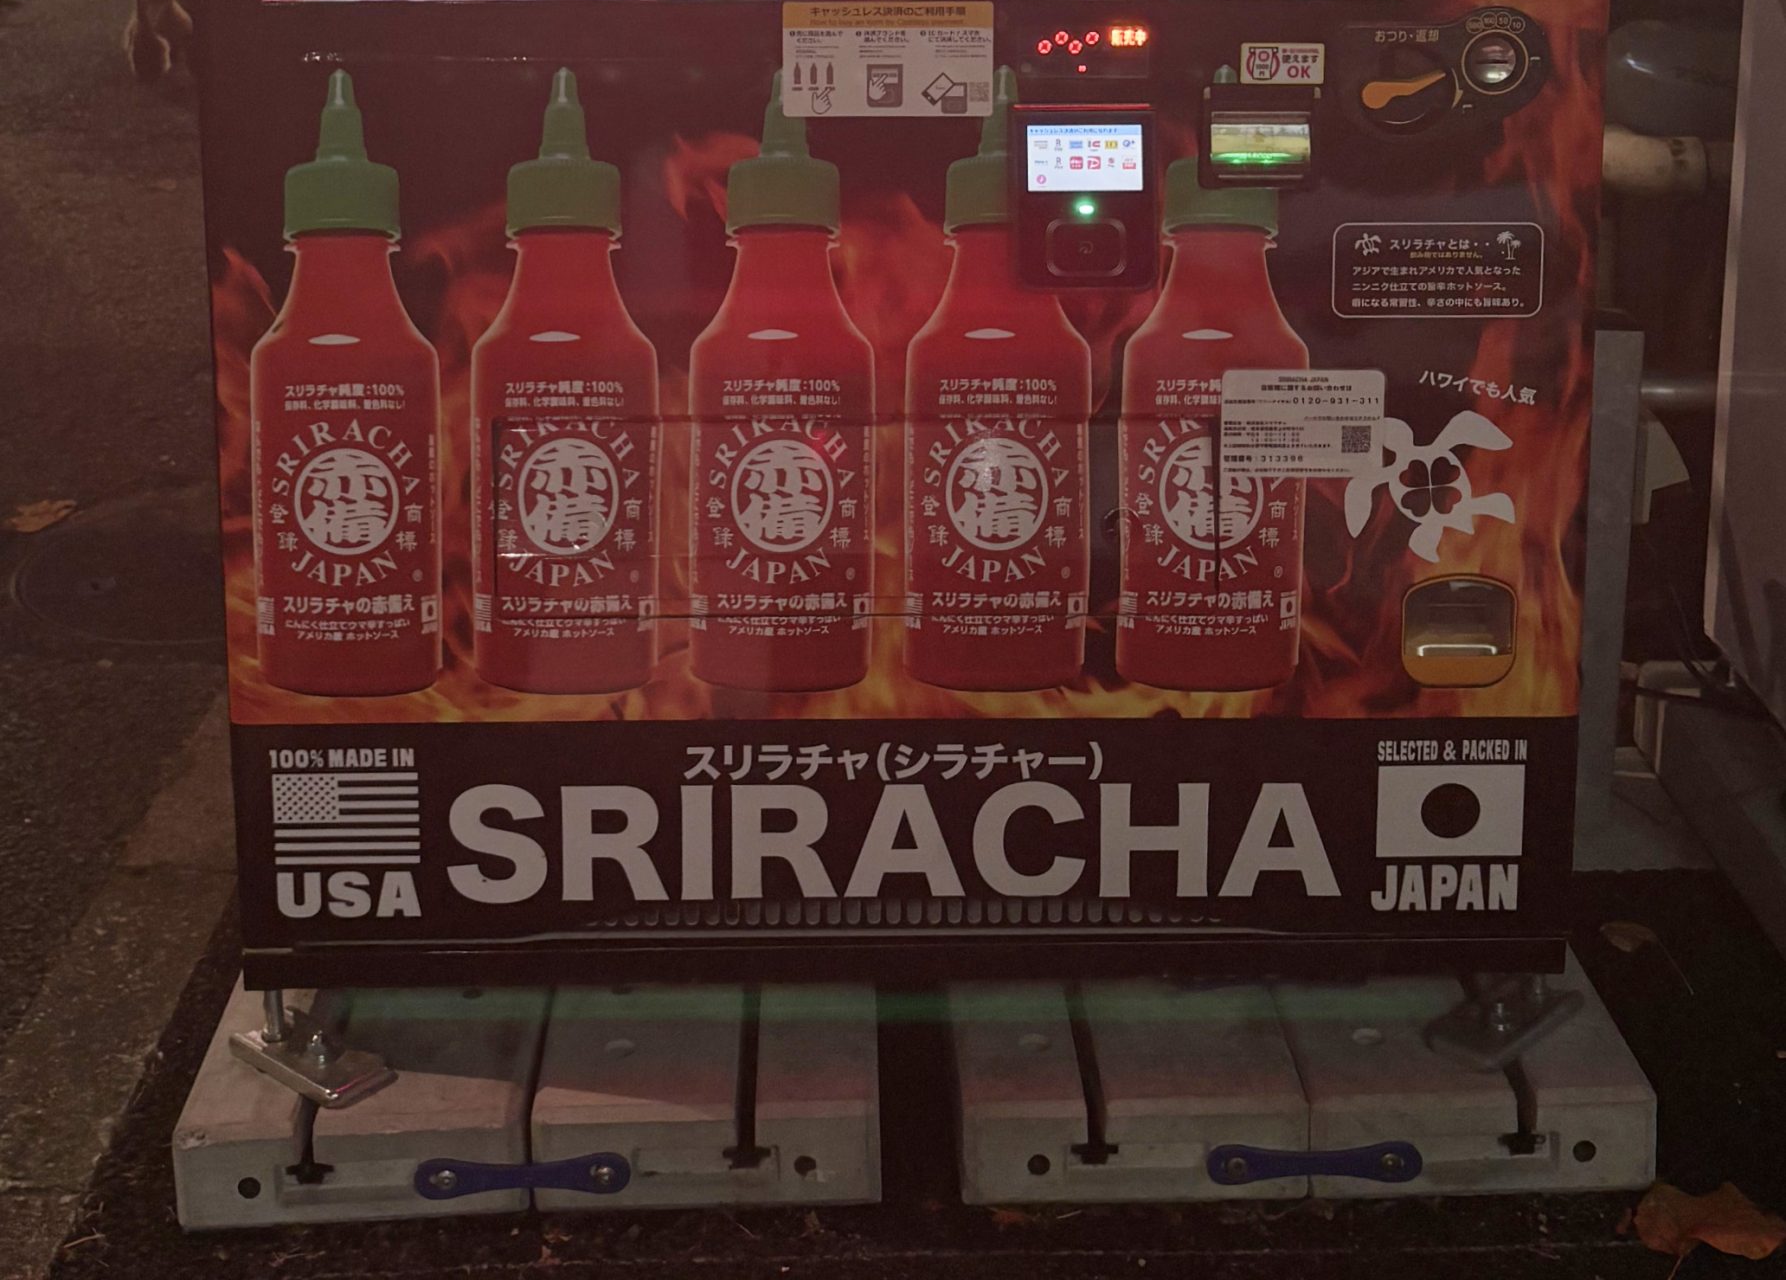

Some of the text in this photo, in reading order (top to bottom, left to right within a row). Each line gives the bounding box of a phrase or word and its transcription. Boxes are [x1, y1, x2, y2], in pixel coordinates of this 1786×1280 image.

[809, 6, 966, 17] キャッシュレス決済のご利用手順
[1111, 29, 1148, 46] 販売中
[1375, 30, 1439, 42] おつり・返却
[1287, 65, 1311, 78] OK
[1352, 266, 1521, 276] アジアで生まれアメリカで人気となった
[1293, 397, 1380, 406] 0120-931-311
[1419, 370, 1537, 405] ハワイでも人気
[272, 419, 421, 496] SRIRACHA
[501, 420, 642, 490] SRIRACHA
[709, 418, 856, 489] SRIRACHA
[924, 417, 1070, 489] SRIRACHA
[292, 549, 398, 587] JAPAN
[509, 552, 615, 587] JAPAN
[725, 547, 832, 585] JAPAN
[941, 545, 1047, 583] JAPAN
[1157, 545, 1259, 582] JAPAN
[283, 594, 415, 615] スリラチャの赤備え
[502, 594, 633, 614] スリラチャの赤備え
[717, 592, 848, 611] スリラチャの赤備え
[932, 590, 1062, 610] スリラチャの赤備え
[1146, 590, 1274, 610] スリラチャの赤備え
[270, 748, 415, 768] 100% MADE IN
[683, 741, 1104, 782] スリラチャ(シラチャー)
[1377, 739, 1528, 762] SELECTED & PACKED IN
[447, 781, 1342, 904] SRIRACHA
[276, 871, 422, 918] USA
[1371, 863, 1519, 912] JAPAN
